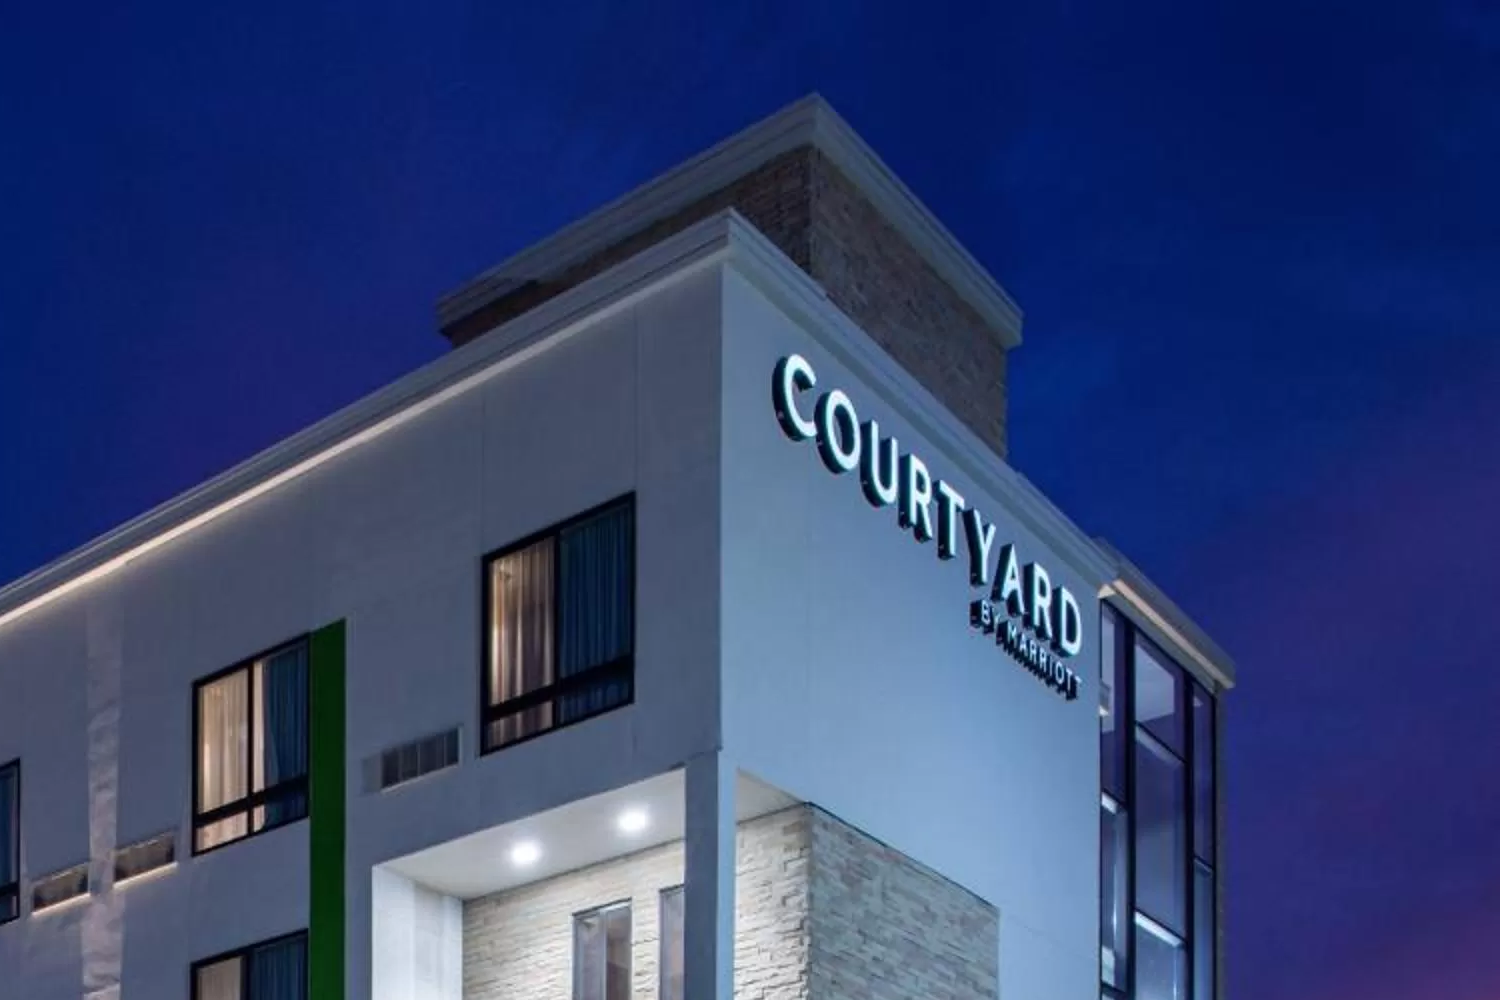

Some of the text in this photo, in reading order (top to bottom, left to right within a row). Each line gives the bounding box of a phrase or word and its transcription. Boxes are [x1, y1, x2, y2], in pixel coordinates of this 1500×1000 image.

[773, 353, 1083, 658] COURTYARD
[973, 599, 1083, 697] BY MARRIOTT
